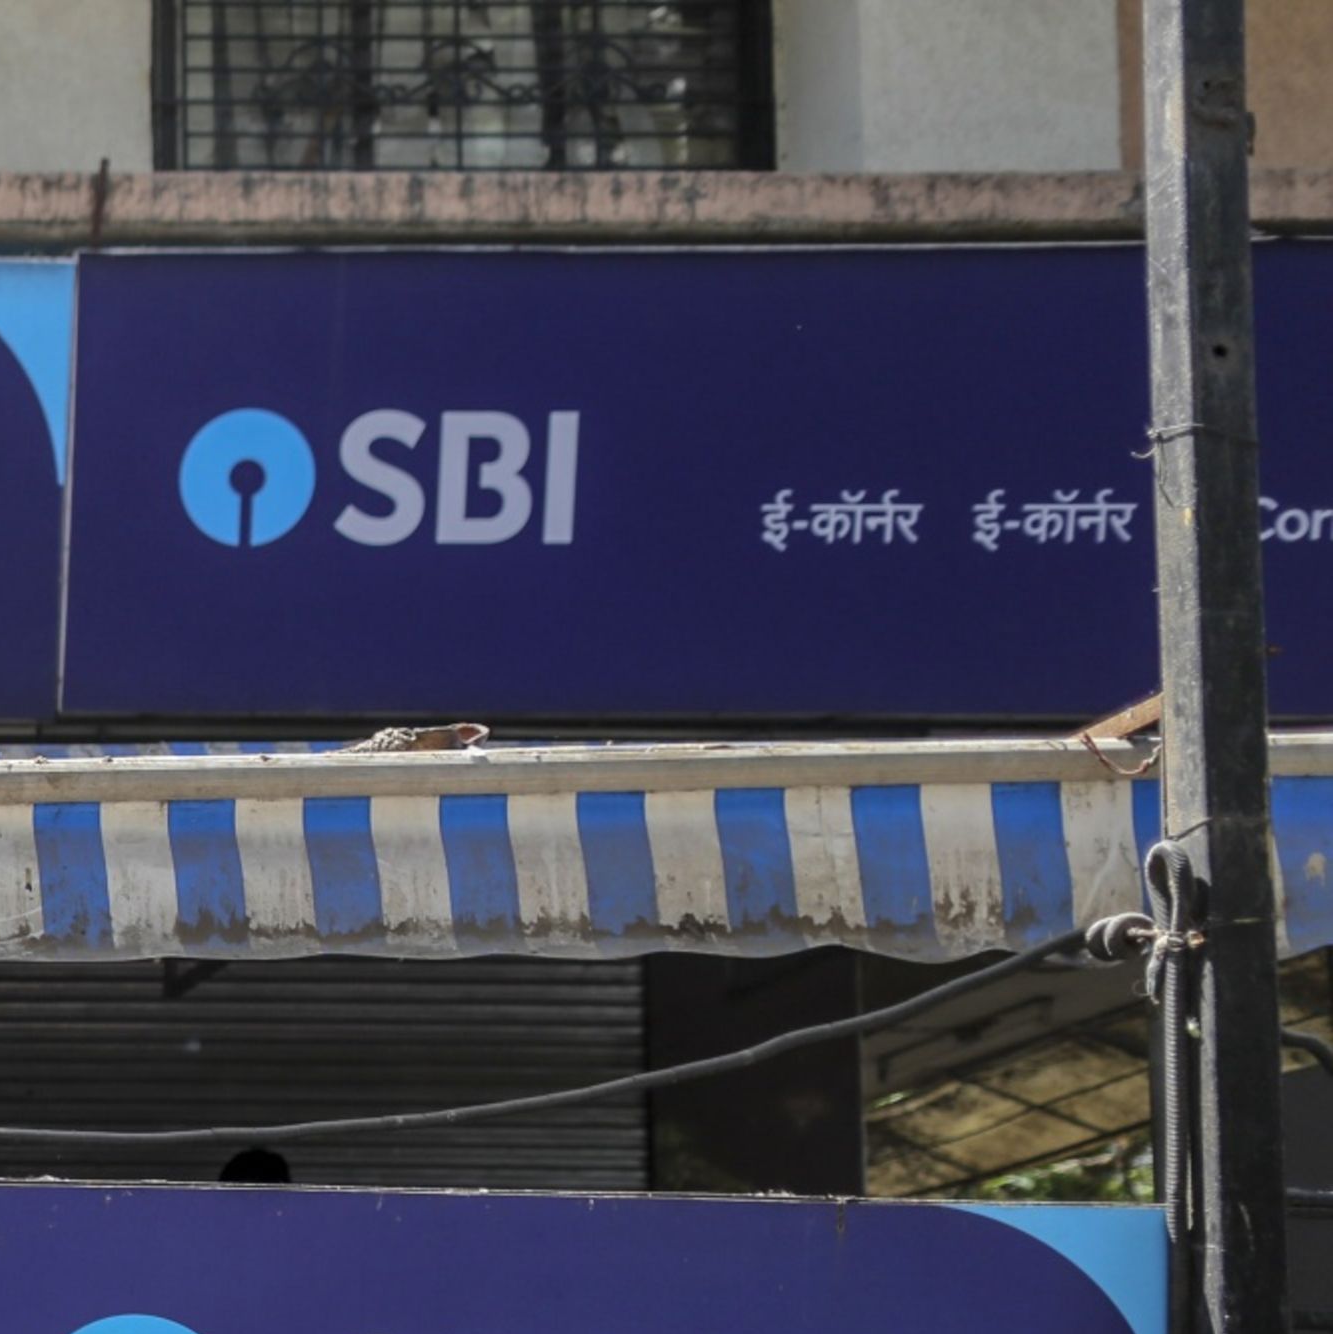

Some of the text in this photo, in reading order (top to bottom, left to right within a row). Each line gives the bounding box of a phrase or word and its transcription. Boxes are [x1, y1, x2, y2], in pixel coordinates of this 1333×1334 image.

[333, 408, 580, 547] SBI
[761, 489, 1138, 551] ई-कॉर्नर ई-कॉर्नर
